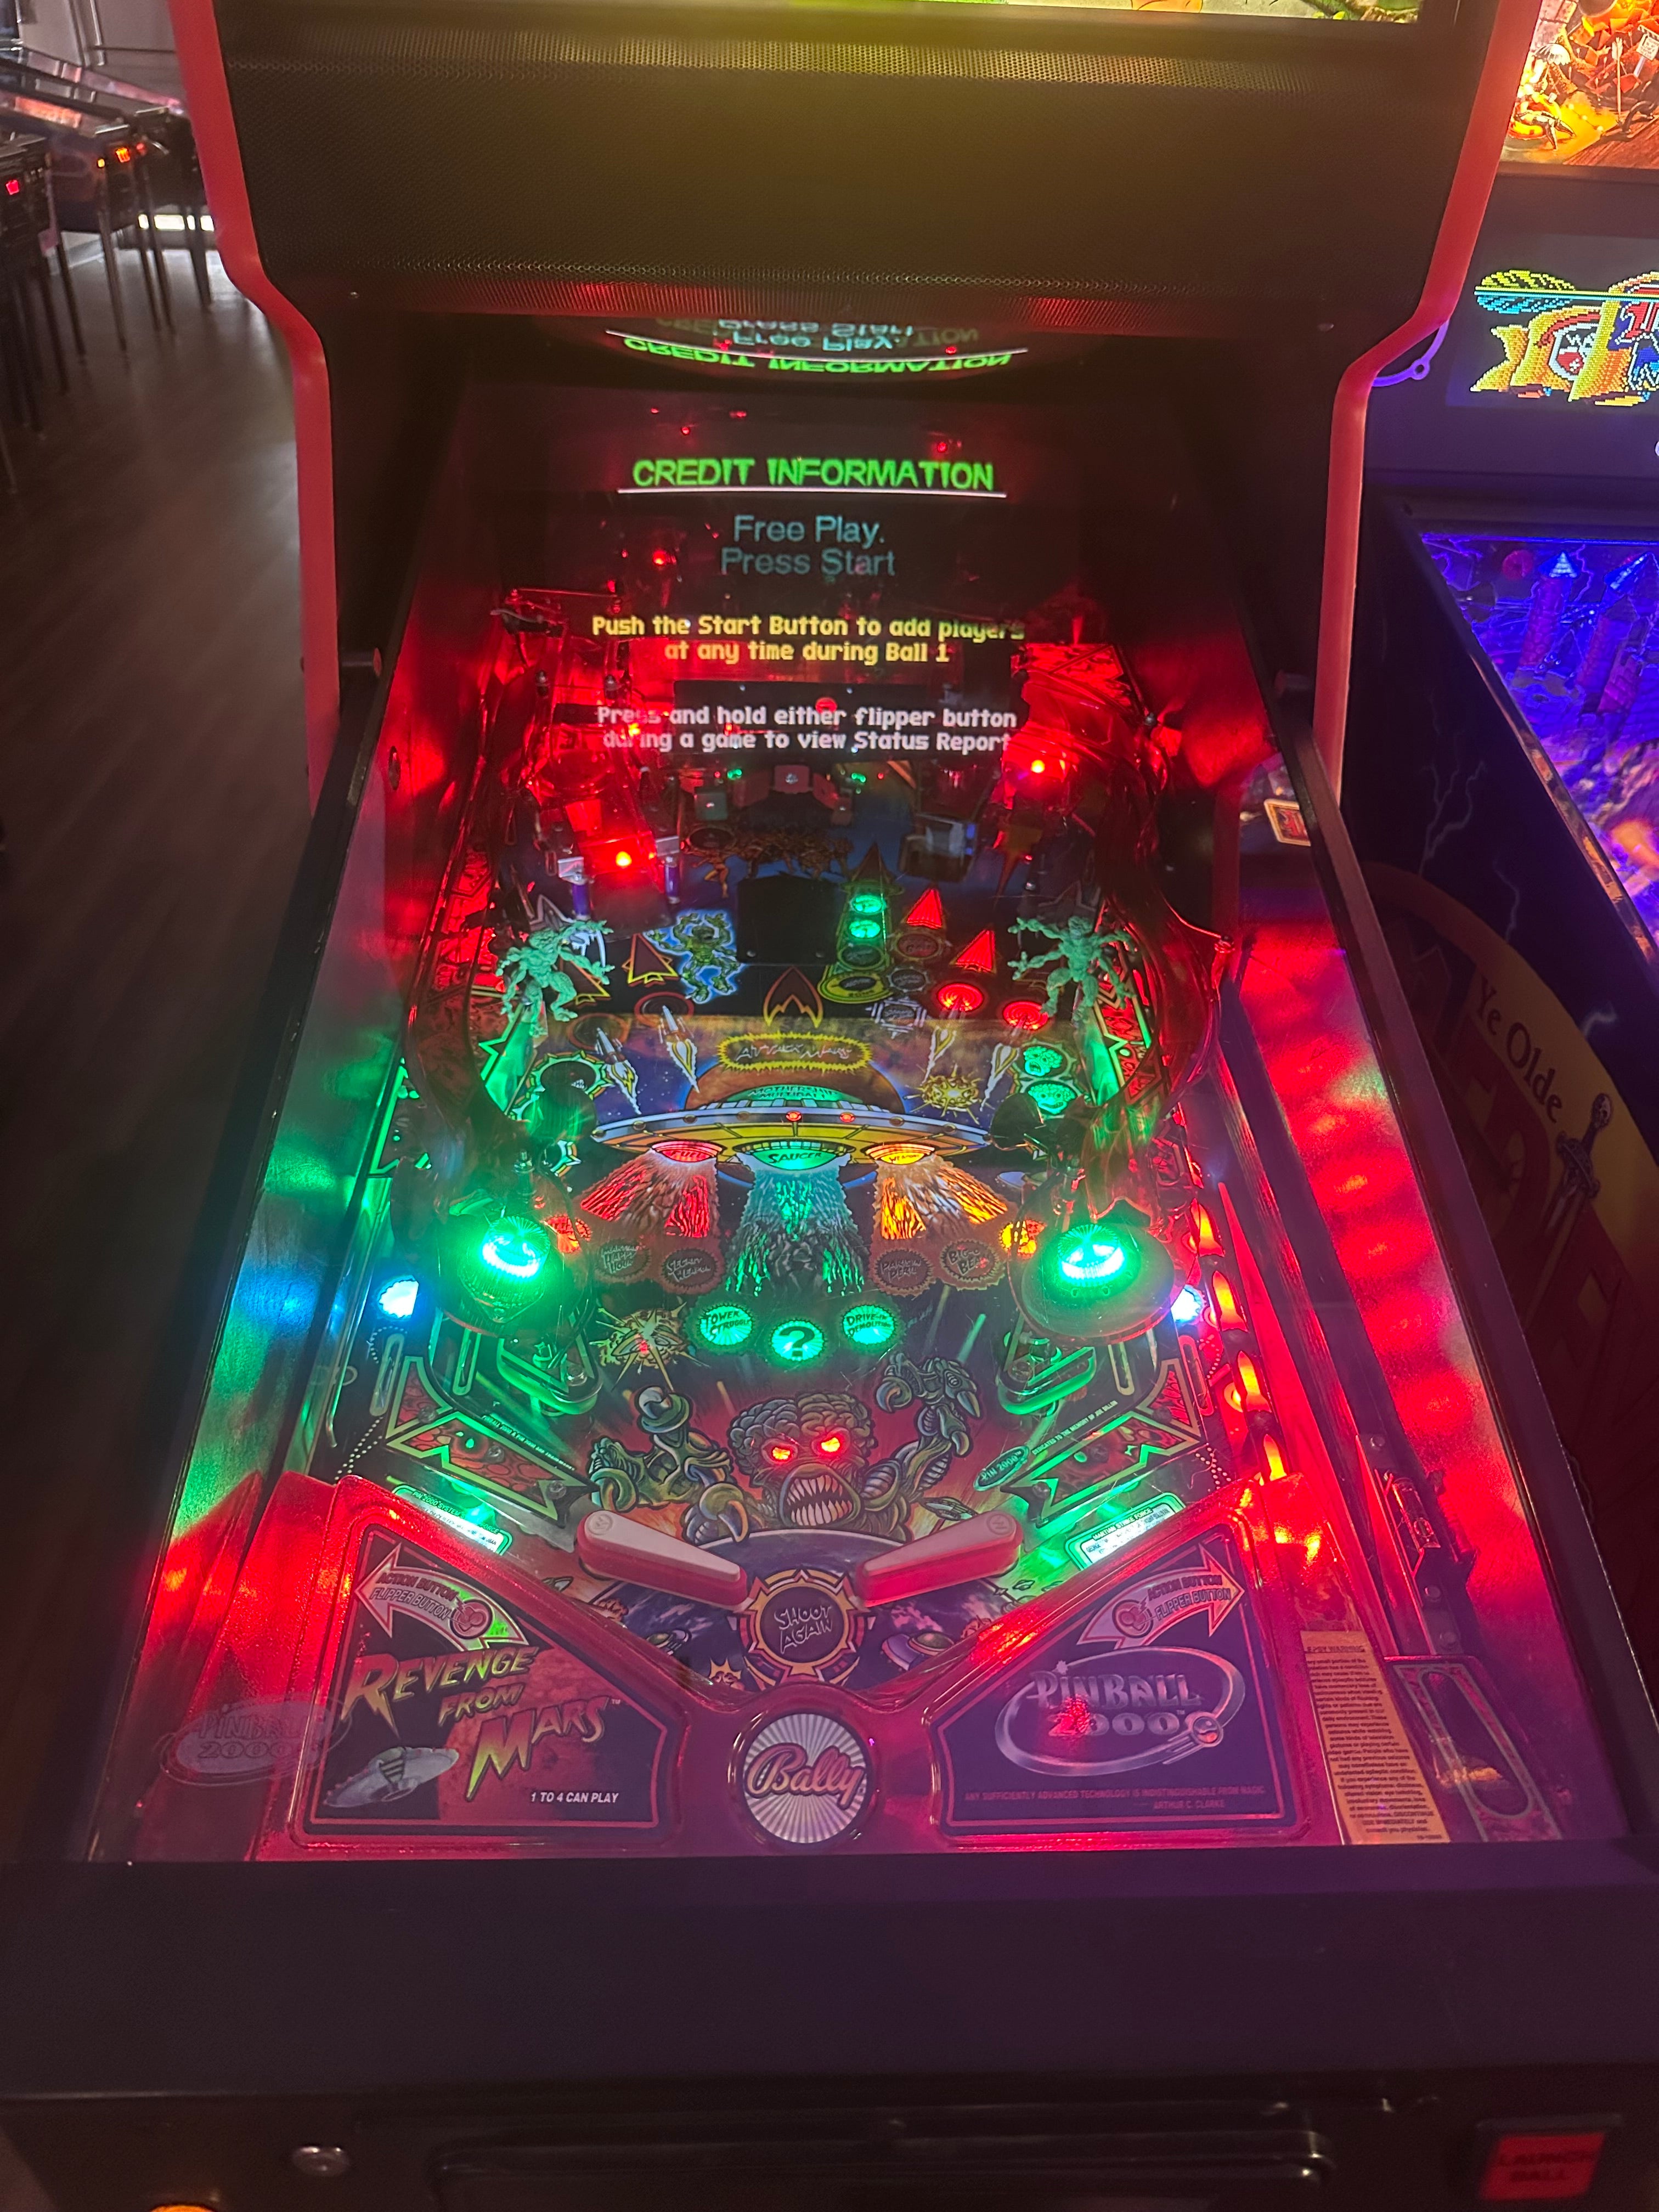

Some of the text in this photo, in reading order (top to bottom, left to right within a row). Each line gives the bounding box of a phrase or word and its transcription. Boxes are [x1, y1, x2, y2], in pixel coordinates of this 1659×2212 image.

[632, 458, 994, 490] CREDIT INFORMATION
[733, 515, 885, 549] Free Play.
[720, 549, 895, 576] Press Start
[592, 615, 1025, 644] Push the Start Button to add players
[665, 642, 950, 665] at any time during Ball 1
[669, 706, 710, 724] and
[717, 706, 766, 725] hold
[775, 707, 842, 725] either
[855, 707, 935, 732] flipper
[943, 708, 1017, 727] button
[680, 734, 693, 748] a
[702, 733, 755, 753] game
[765, 732, 789, 749] to
[797, 732, 846, 749] view
[854, 731, 930, 751] Status
[936, 732, 1009, 752] Report
[1476, 979, 1565, 1124] Ye Olde
[768, 1152, 822, 1164] SAUCER
[602, 1250, 637, 1269] HAPPY
[703, 1310, 740, 1330] TOWER
[779, 1326, 815, 1357] ?
[980, 1466, 998, 1481] PIN
[412, 1490, 423, 1500] PIN
[438, 1502, 461, 1517] SYSTEM
[1092, 1506, 1154, 1541] MARTIAN STRIKE FORCE
[376, 1572, 459, 1602] ACTION BUTTON
[1147, 1575, 1223, 1601] ACTION BUTTON
[370, 1587, 452, 1621] FLIPPER BUTTON
[774, 1604, 832, 1632] SHOOT
[1154, 1588, 1232, 1621] FLIPPER BUTTON
[780, 1618, 833, 1654] AGAIN
[340, 1646, 540, 1739] REVENGE
[438, 1683, 527, 1726] FROM
[1025, 1671, 1203, 1709] PINBALL
[465, 1694, 611, 1802] MARS
[744, 1742, 866, 1810] Bally
[530, 1792, 619, 1803] 1 TO 4 CAN PLAY
